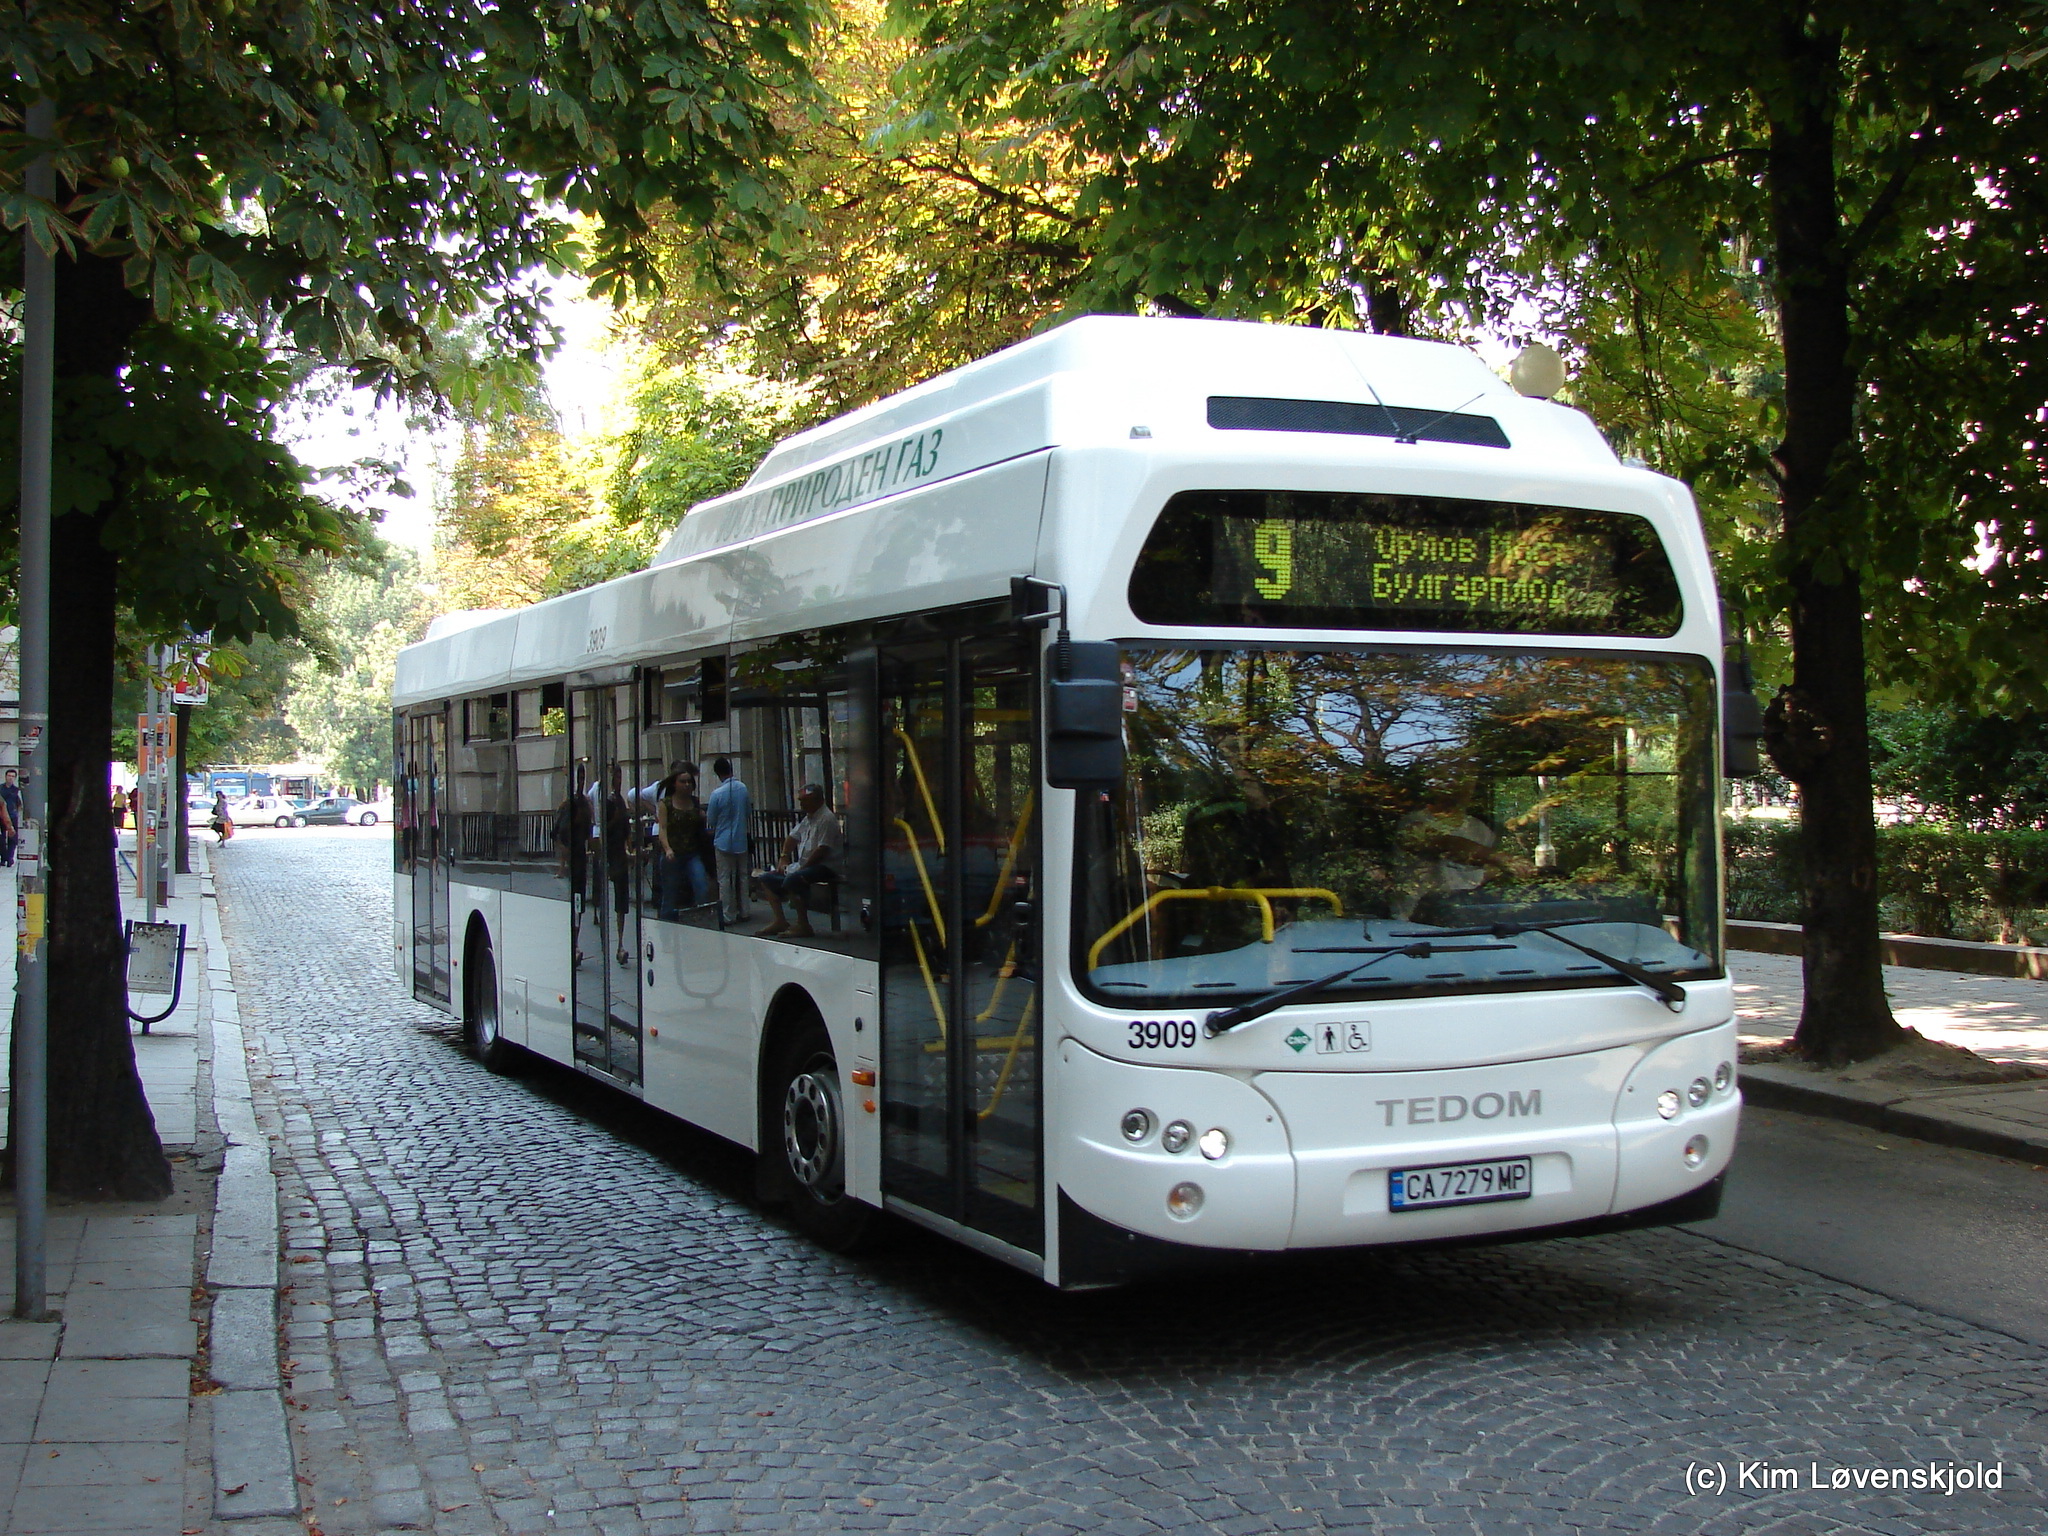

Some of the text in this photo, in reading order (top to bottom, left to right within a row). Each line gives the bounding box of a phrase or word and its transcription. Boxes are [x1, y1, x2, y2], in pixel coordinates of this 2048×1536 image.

[764, 446, 892, 525] ПРИРОДЕН
[893, 428, 943, 484] ГАЗ
[1254, 518, 1292, 600] 9
[587, 625, 607, 653] 3909
[1128, 1020, 1196, 1048] 3909
[1376, 1089, 1541, 1126] TEDOM
